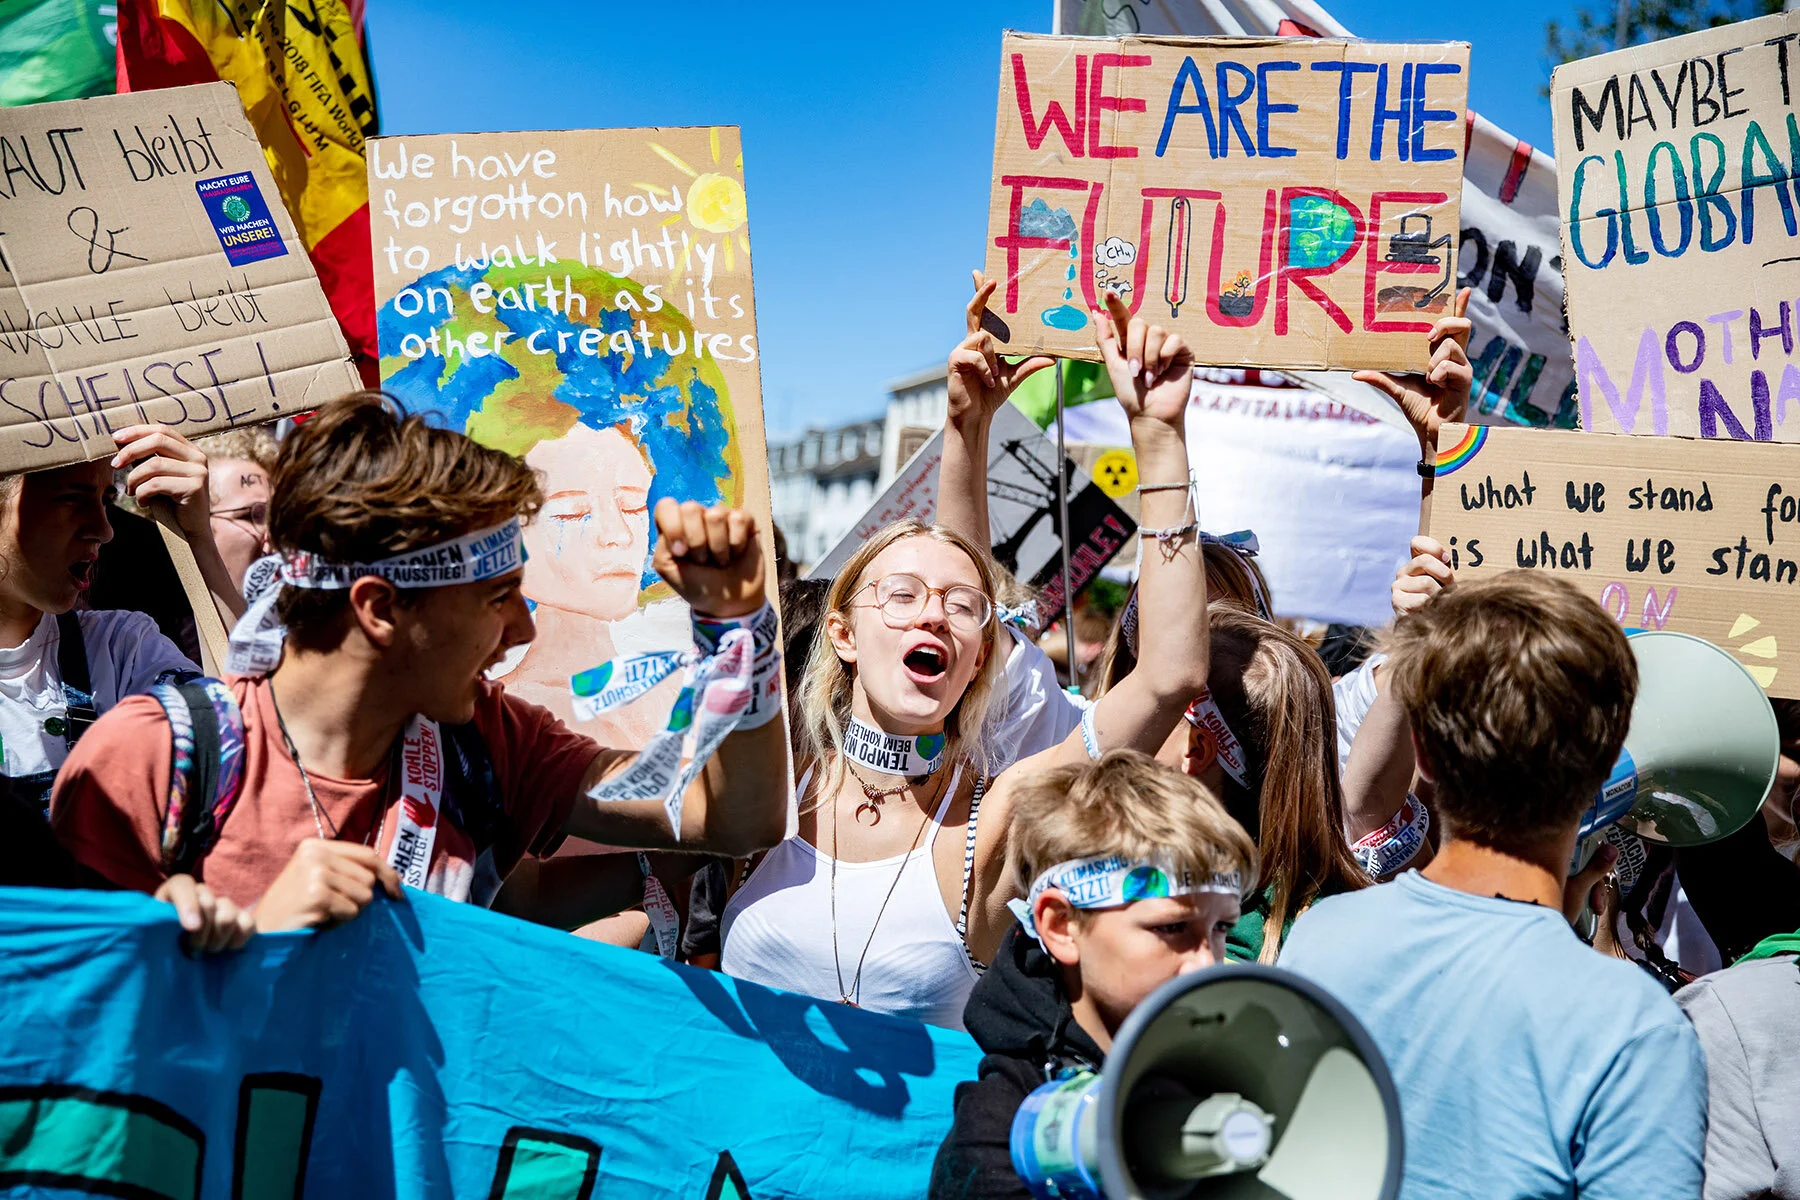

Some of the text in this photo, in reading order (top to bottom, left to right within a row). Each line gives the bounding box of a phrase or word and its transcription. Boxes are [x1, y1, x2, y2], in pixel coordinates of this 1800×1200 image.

[277, 38, 311, 75] 2018
[304, 69, 334, 107] FIFA
[329, 104, 361, 147] World
[1010, 53, 1462, 163] WE ARE THE
[1571, 32, 1800, 152] MAYBE T
[0, 114, 225, 200] AUT bleibt
[372, 139, 558, 182] We have
[199, 174, 251, 192] MACHT EURE
[382, 180, 683, 234] forgotton how
[66, 205, 149, 275] &
[218, 218, 270, 235] WIR MACHEN
[222, 226, 276, 247] UNSERE!
[383, 225, 717, 290] to walk lightly
[994, 175, 1449, 337] FUTURE
[162, 273, 269, 333] bleibt
[393, 274, 746, 320] on earth as its
[399, 320, 757, 364] other creatures
[1577, 297, 1800, 437] MOTH
[0, 341, 281, 449] SCHEISSE!
[240, 472, 263, 489] ACT
[1460, 470, 1537, 511] what
[1565, 480, 1606, 513] we
[1628, 478, 1714, 513] stand
[472, 541, 517, 578] JETZT!
[1450, 536, 1484, 571] is
[1516, 530, 1595, 571] what
[1625, 537, 1676, 575] we
[1601, 580, 1679, 631] ON
[883, 736, 912, 753] BEIM
[1202, 710, 1240, 751] KOHLE
[404, 736, 423, 786] KOHLE
[420, 723, 438, 793] STOPPEN!
[859, 743, 909, 772] TEMPO
[1379, 835, 1422, 875] KLIMASCH
